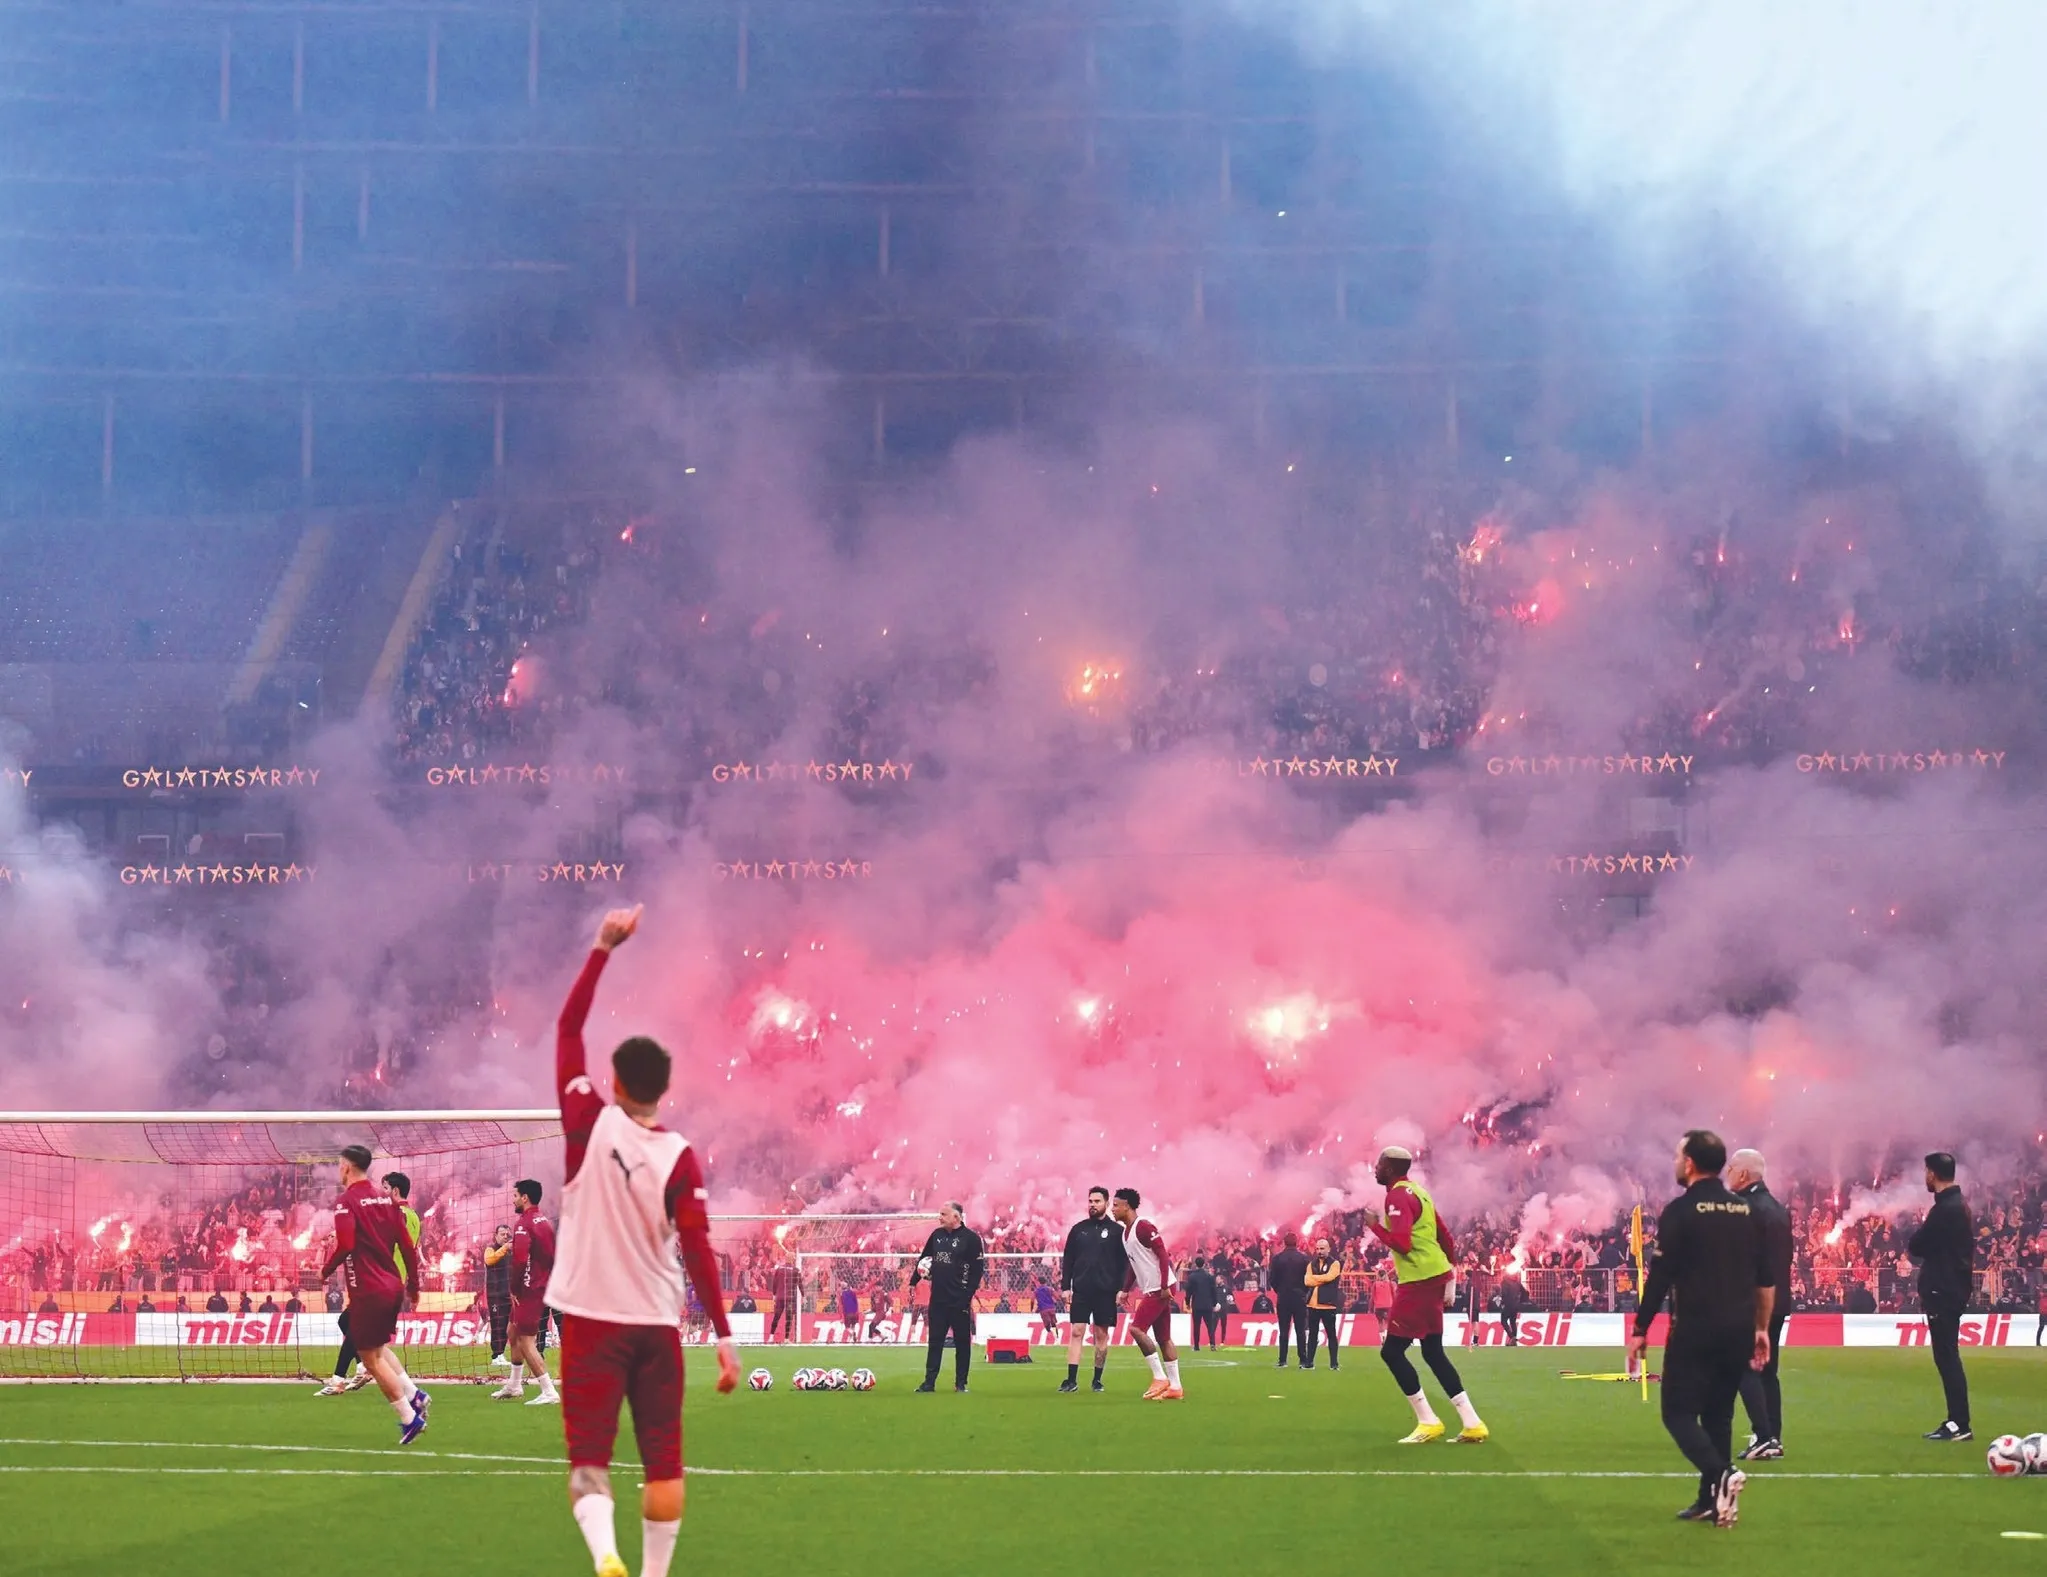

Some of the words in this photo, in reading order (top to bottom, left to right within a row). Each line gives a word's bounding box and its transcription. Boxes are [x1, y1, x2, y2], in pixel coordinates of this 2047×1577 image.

[123, 765, 320, 788] GALATASARAY
[427, 763, 625, 785] GALATASAY
[712, 759, 913, 783] GALATASARAY
[1238, 754, 1399, 777] LATASARAY
[120, 862, 318, 885] GALATASARAY
[712, 857, 873, 881] GALATASAR
[185, 1312, 294, 1344] misli
[395, 1312, 491, 1345] mis
[1458, 1312, 1573, 1346] msli
[1895, 1313, 2012, 1346] msli
